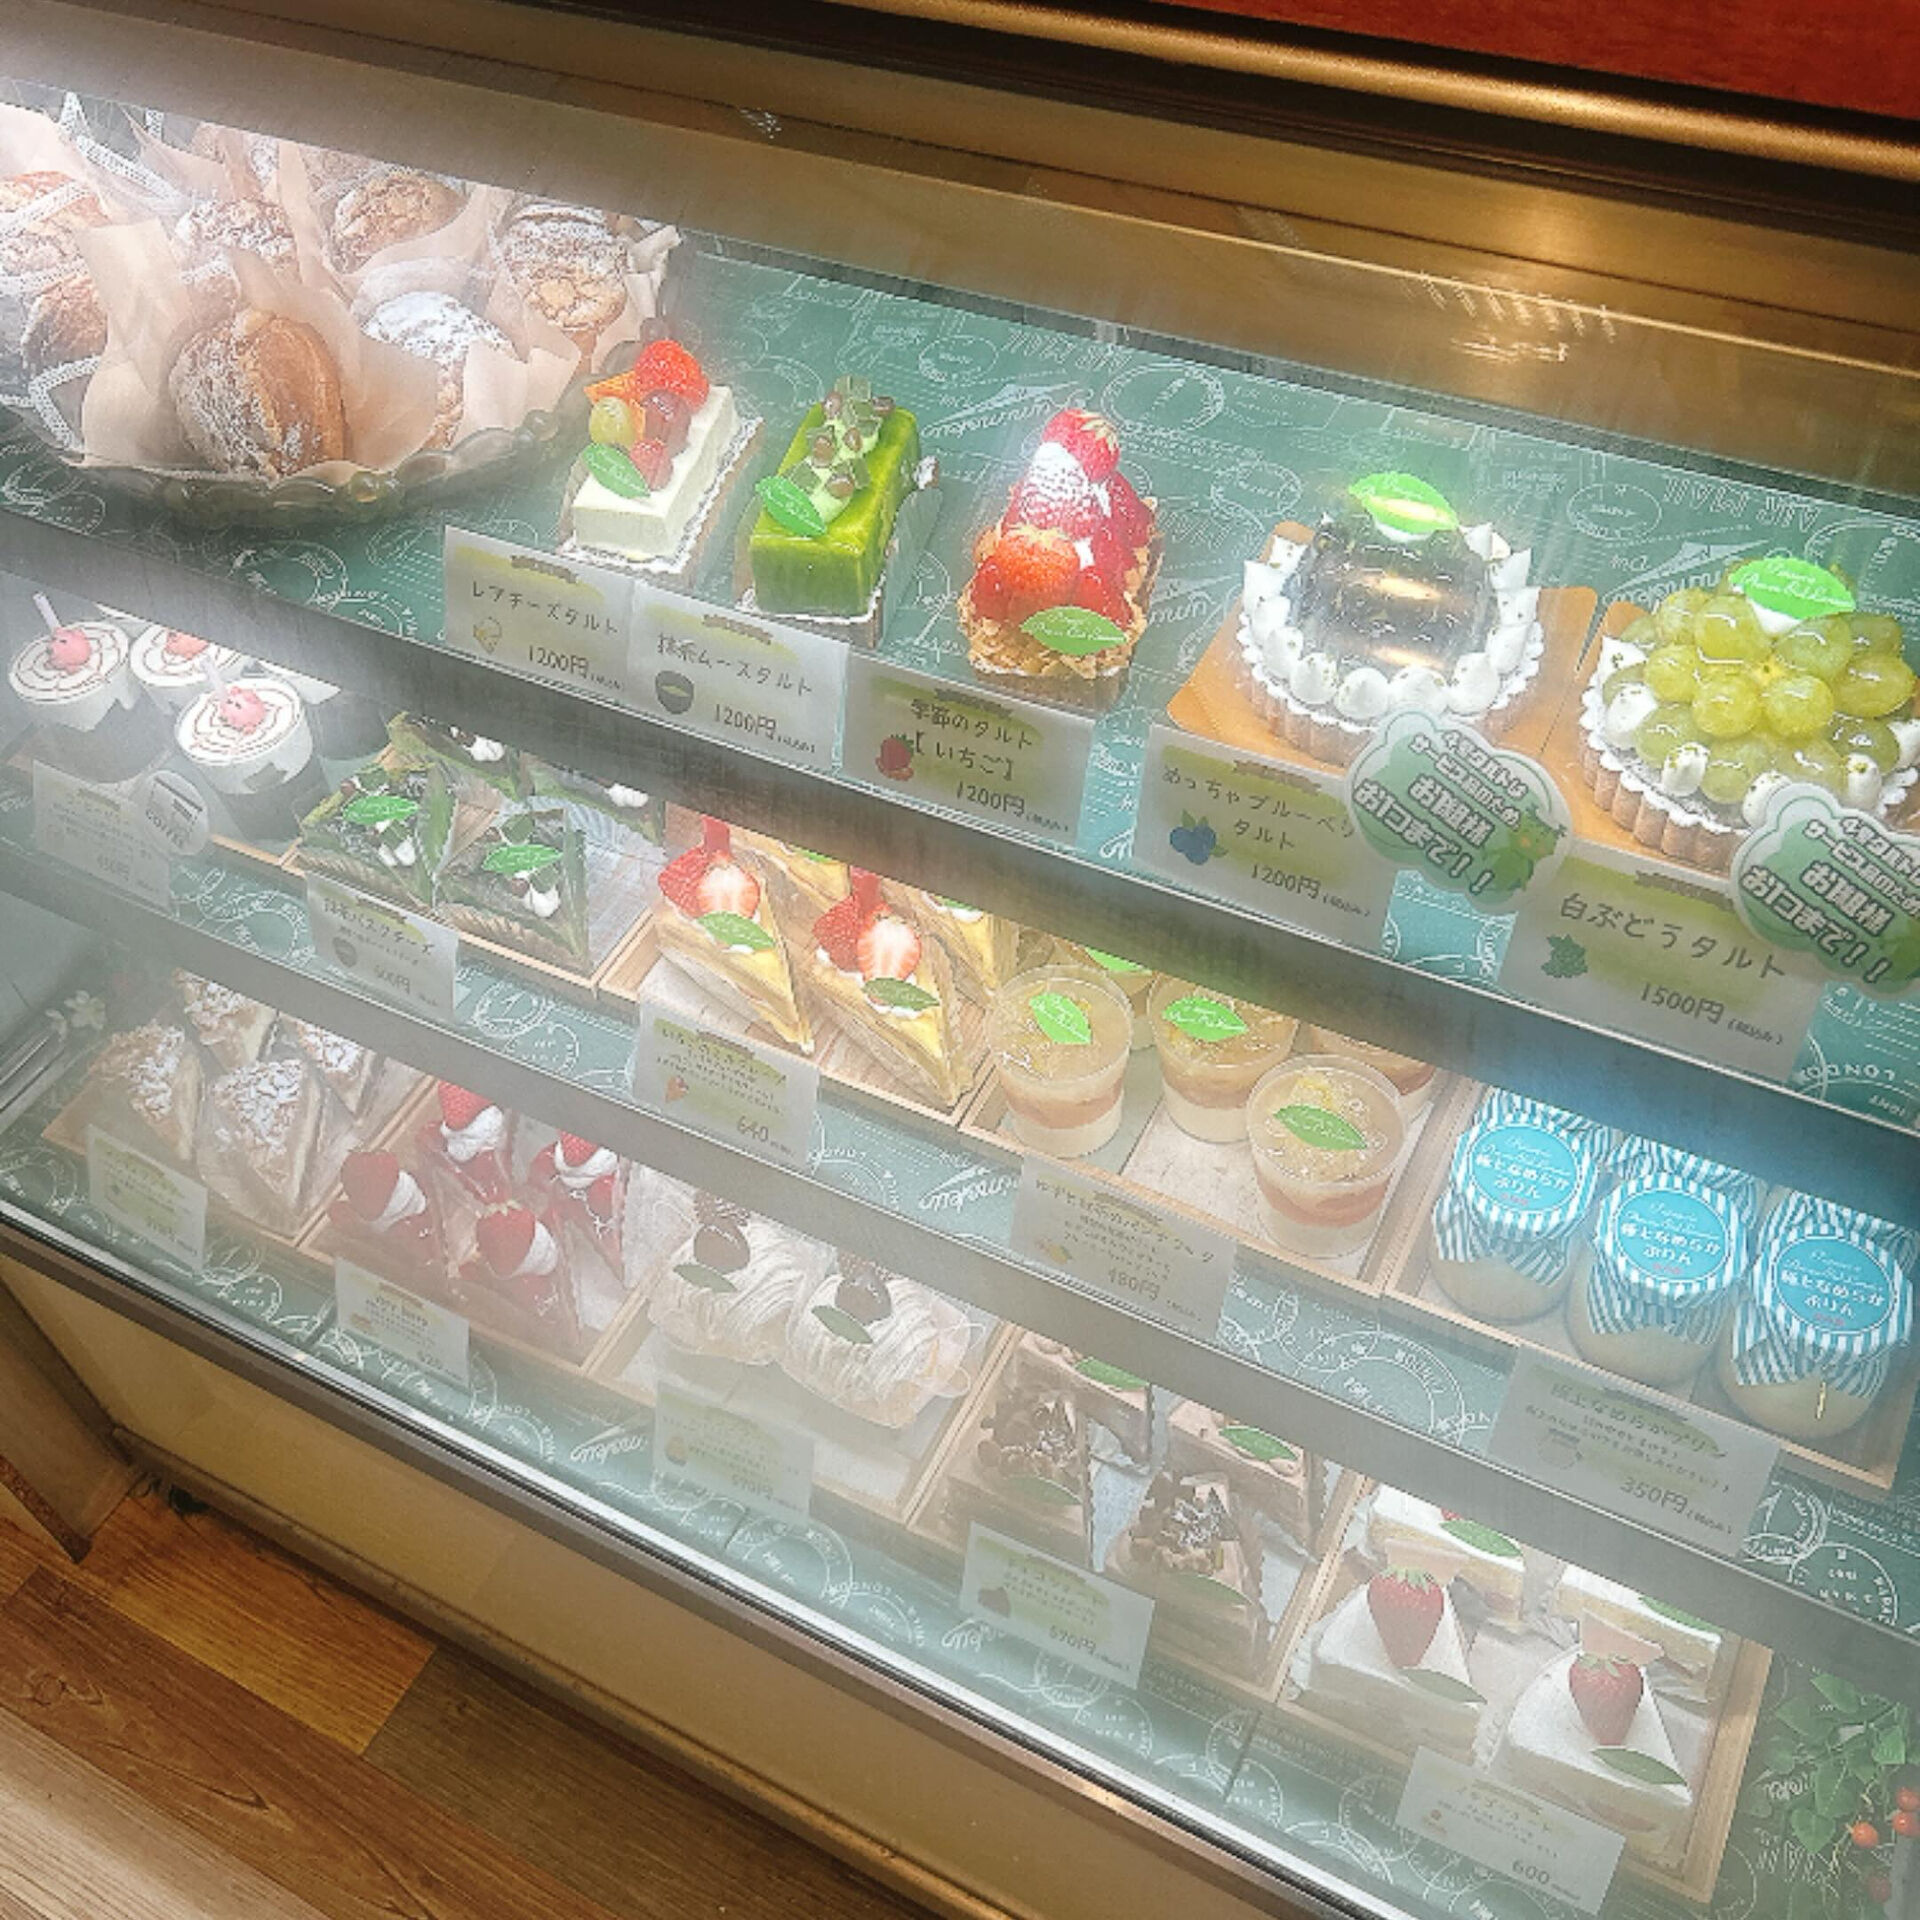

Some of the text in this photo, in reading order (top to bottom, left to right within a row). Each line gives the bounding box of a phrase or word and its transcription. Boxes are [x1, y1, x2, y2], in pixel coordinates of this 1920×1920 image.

[472, 579, 619, 635] レアチーズタルト
[528, 643, 591, 682] 1200円
[657, 631, 814, 698] 抹茶ムースタルト
[714, 702, 777, 741] 1200円
[911, 697, 1034, 750] 季節のタルト
[915, 731, 1014, 782] 【いちご】
[956, 781, 1027, 819] 1200円
[1232, 818, 1296, 852] タルト
[1250, 862, 1321, 901] 1200円
[1559, 891, 1786, 980] 白ぶどうタルト
[1640, 981, 1725, 1026] 1500円
[1620, 1475, 1689, 1516] 350円
[1511, 1859, 1550, 1886] 600
